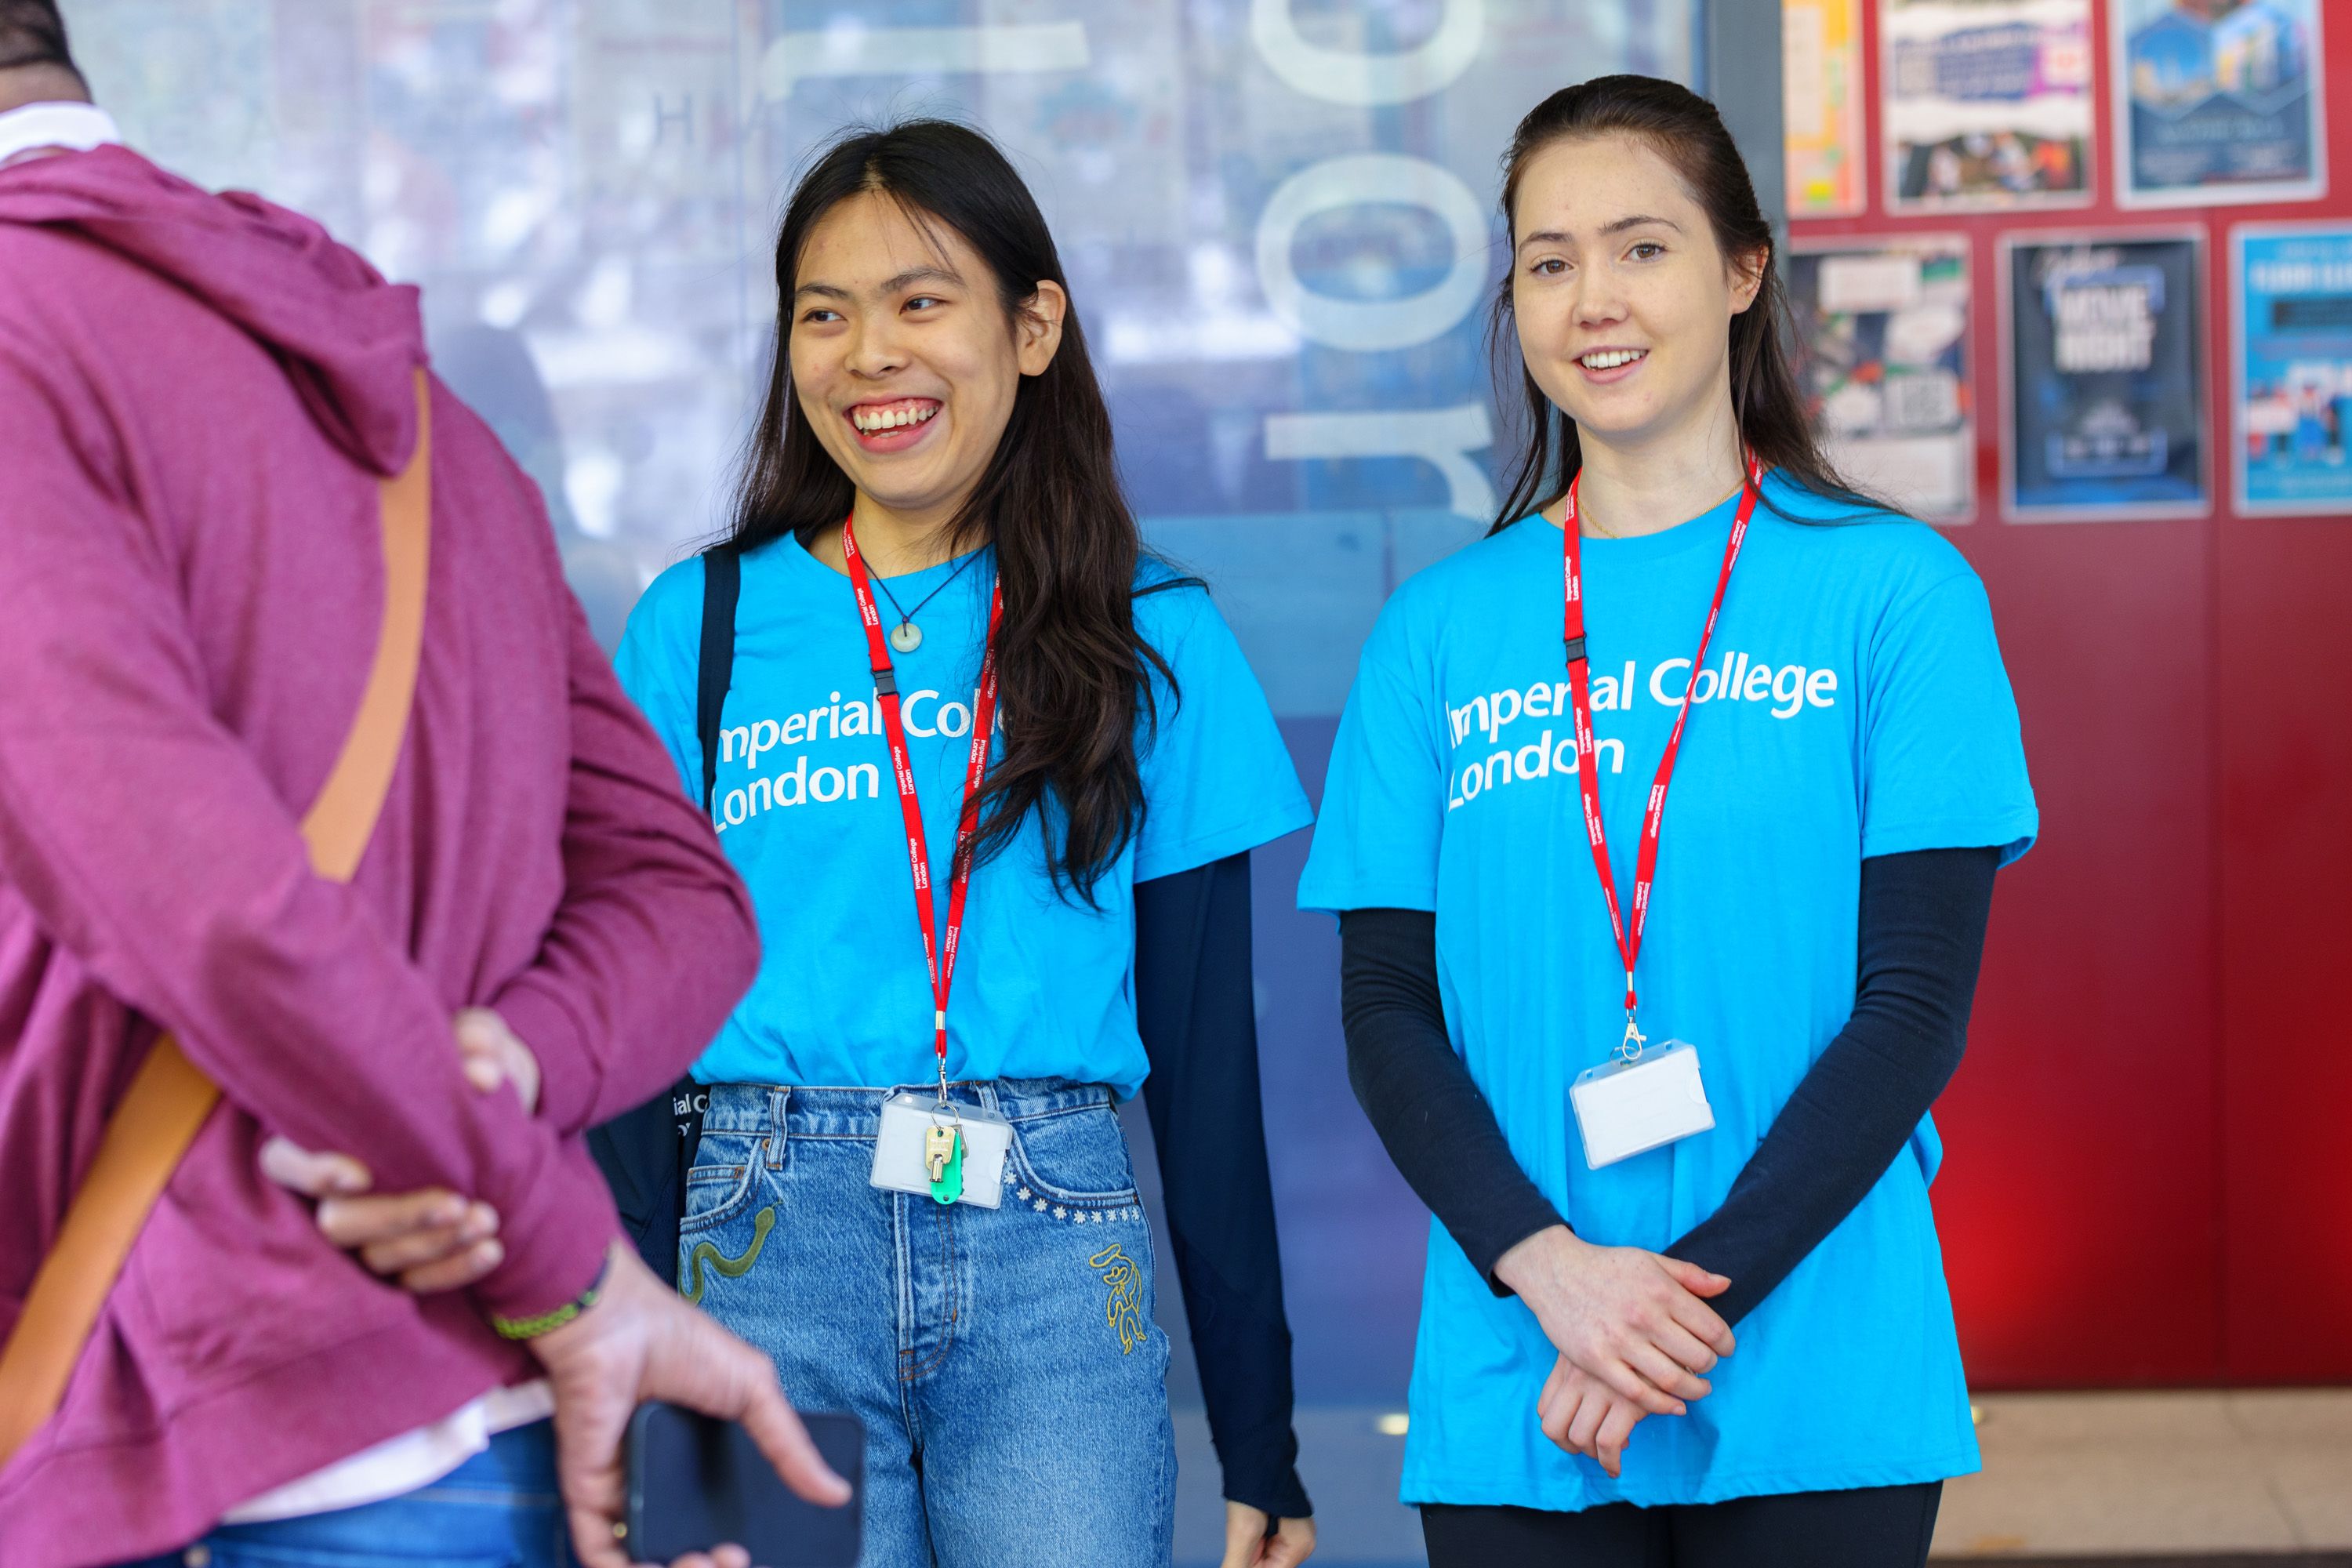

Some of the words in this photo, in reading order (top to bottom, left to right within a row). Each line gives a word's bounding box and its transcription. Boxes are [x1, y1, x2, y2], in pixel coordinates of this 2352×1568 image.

[857, 587, 866, 607] College
[862, 606, 872, 626] Imperial
[868, 604, 879, 626] London
[1446, 661, 1636, 750] Imperal
[1650, 649, 1838, 720] College
[720, 691, 882, 769] mperial
[894, 746, 903, 771] College
[971, 739, 980, 764] London
[977, 739, 987, 764] Imperial
[906, 768, 915, 794] London
[1449, 725, 1626, 812] London
[898, 770, 908, 796] Imperial
[909, 838, 918, 863] College
[911, 863, 921, 891] Imperial
[920, 862, 928, 889] London
[946, 926, 954, 952] London
[950, 927, 959, 953] Imperial
